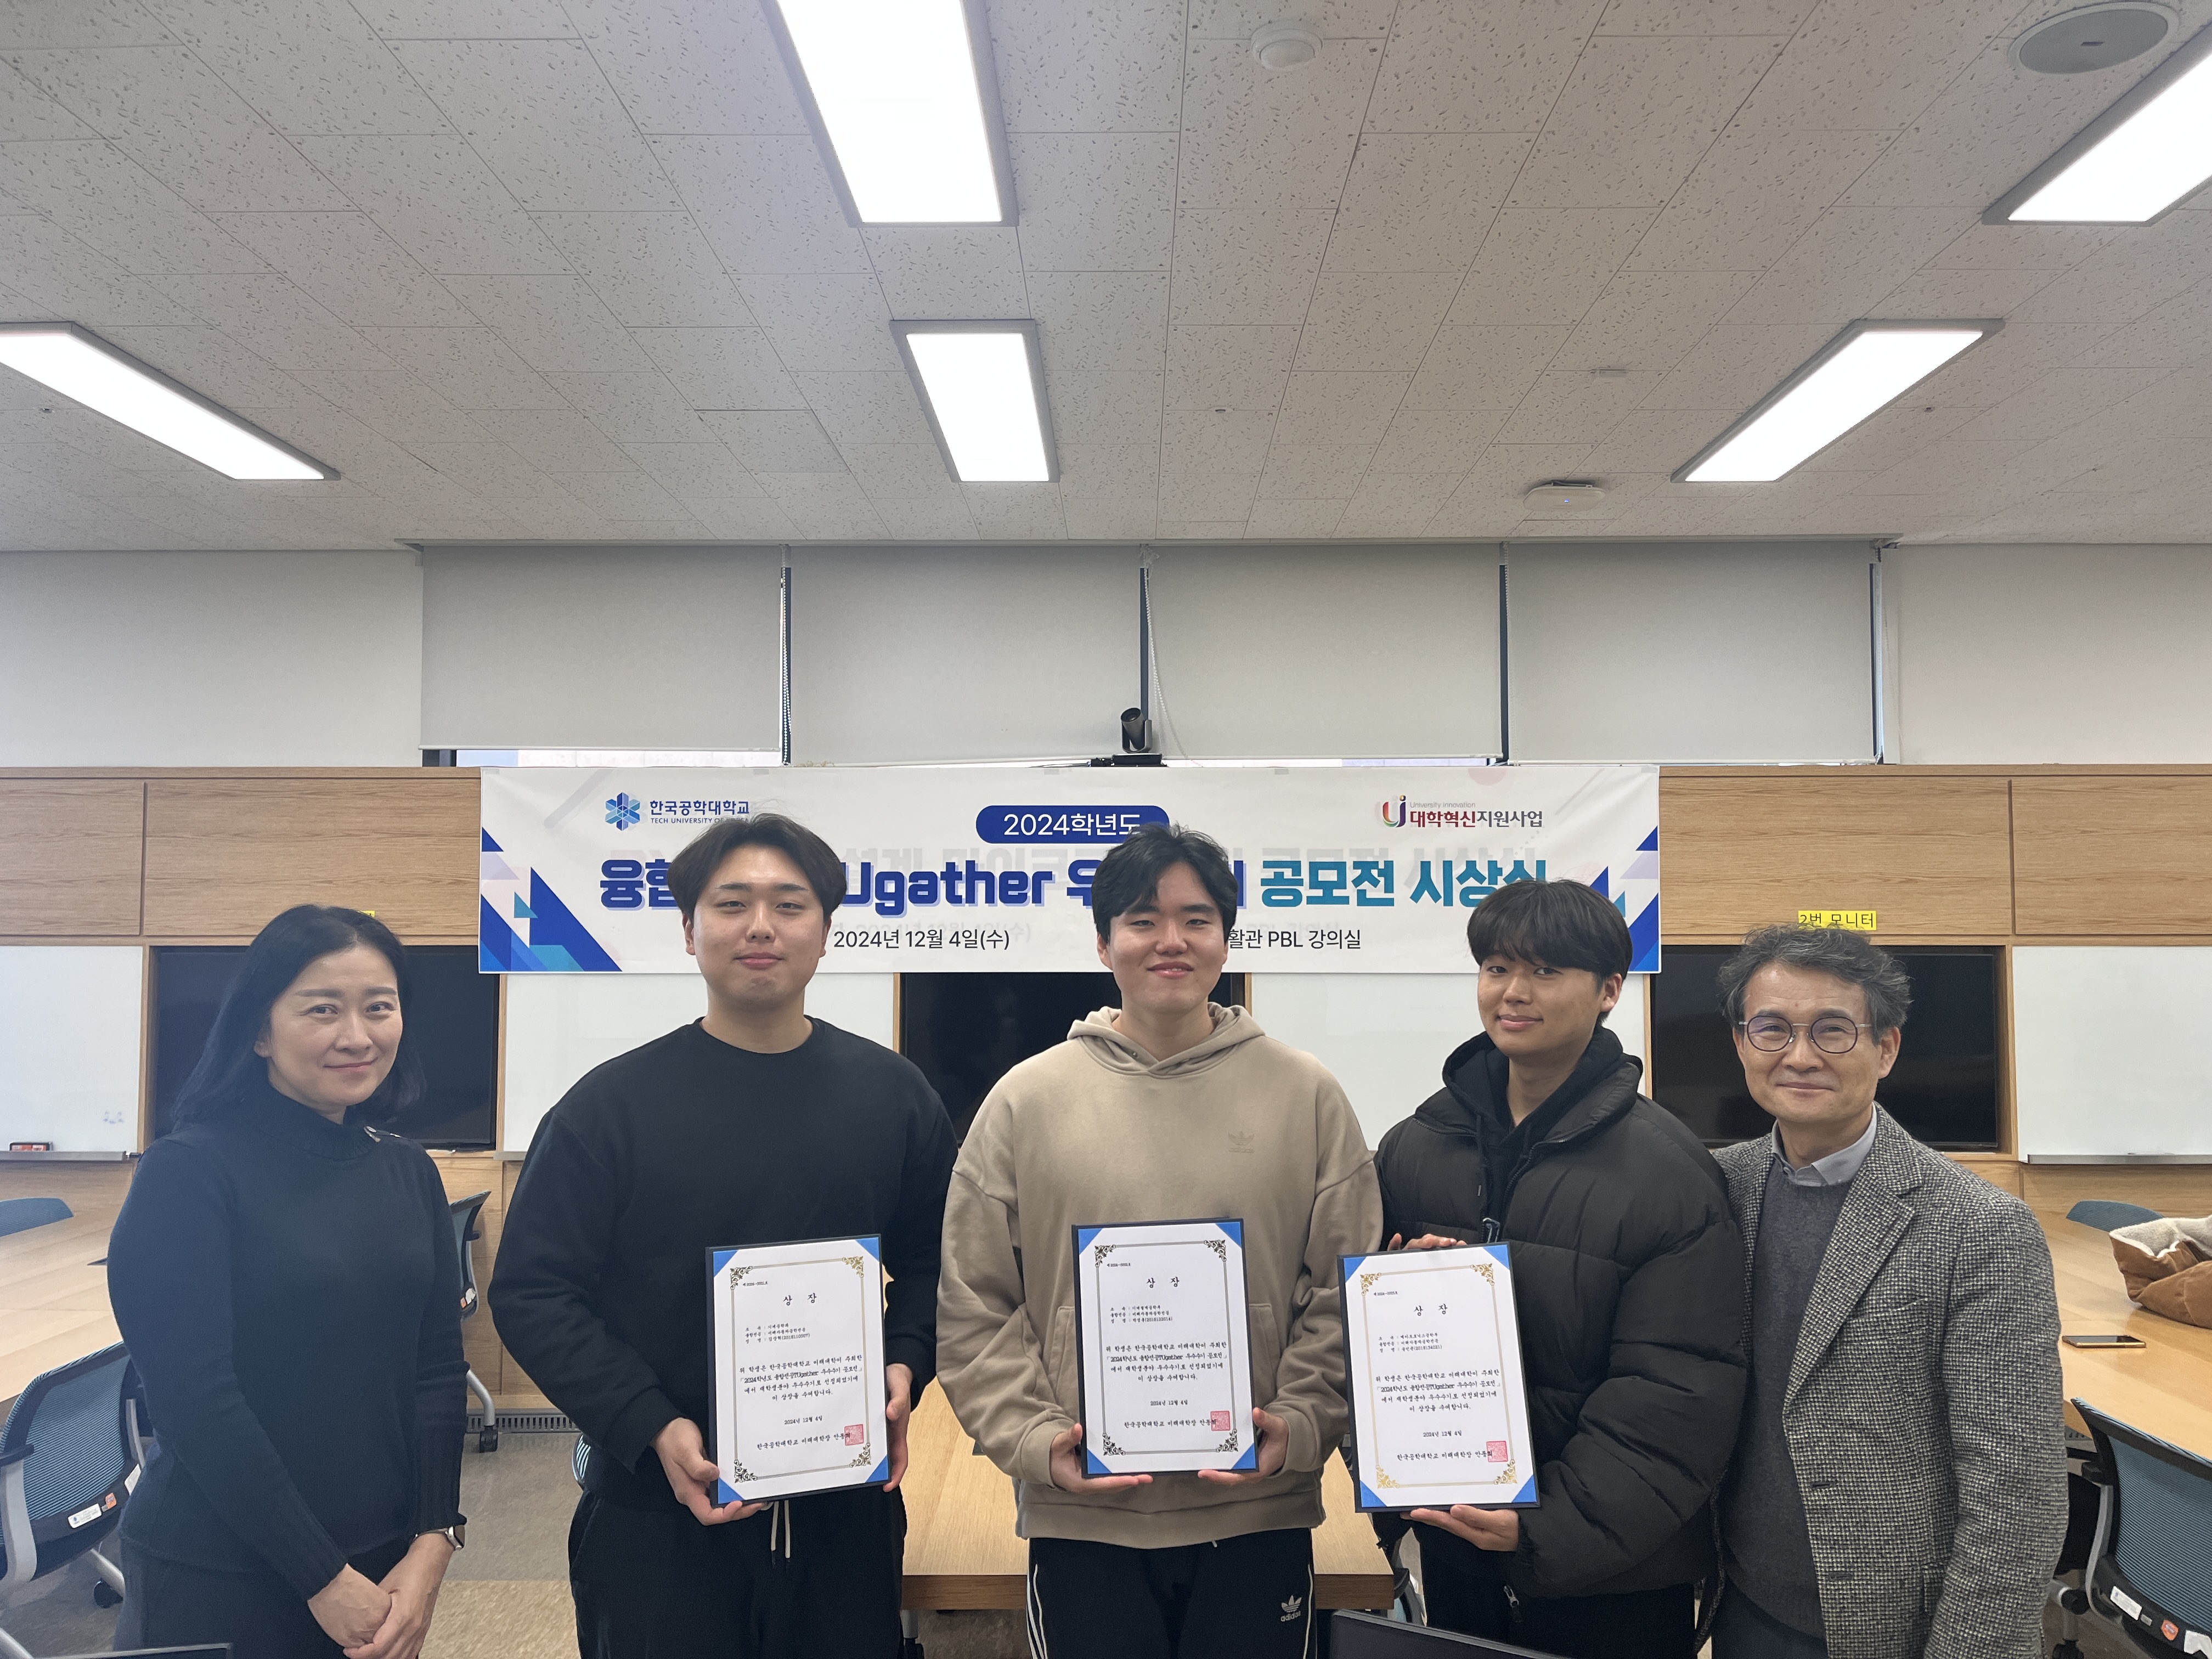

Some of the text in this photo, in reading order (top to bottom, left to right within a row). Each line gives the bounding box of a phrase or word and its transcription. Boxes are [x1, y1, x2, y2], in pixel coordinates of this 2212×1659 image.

[650, 800, 749, 816] 한국공학대학교
[1003, 813, 1141, 836] 2024학년도
[1410, 811, 1542, 827] 대학혁신지원사업
[1261, 860, 1395, 907] 공모전
[1831, 913, 1873, 928] 모니터
[833, 930, 899, 949] 2024년
[906, 930, 943, 949] 12월
[949, 929, 1009, 950] 4일(수)
[1268, 931, 1303, 947] PBL
[1308, 929, 1361, 950] 강의실
[1146, 1276, 1180, 1288] 상 장
[782, 1292, 817, 1306] 상 장
[1413, 1303, 1448, 1316] 상 장
[1177, 1341, 1206, 1350] 미래대학이
[1185, 1351, 1205, 1361] 우수수기
[748, 1364, 766, 1374] 학생은
[769, 1360, 811, 1371] 한국공학대학교
[813, 1356, 841, 1366] 미래대학이
[820, 1366, 840, 1375] 우수수기
[1156, 1363, 1186, 1371] 우수수기로
[1189, 1361, 1223, 1370] 선정되었기에
[1146, 1374, 1164, 1382] 상장을
[1166, 1373, 1198, 1381] 수여합니다.
[1404, 1372, 1446, 1381] 한국공학대학교
[1448, 1370, 1477, 1378] 미래대학이
[791, 1379, 821, 1389] 우수수기로
[824, 1375, 857, 1385] 선정되었기에
[1456, 1380, 1477, 1389] 우수수기
[781, 1392, 799, 1400] 상장을
[801, 1388, 832, 1397] 수여합니다.
[1428, 1392, 1458, 1401] 우수수기로
[1461, 1390, 1497, 1399] 선정되었기에
[1438, 1402, 1471, 1410] 수여합니다.
[1124, 1420, 1165, 1429] 한국공학대학교
[1167, 1419, 1197, 1427] 미래대학장
[757, 1439, 798, 1450] 한국공학대학교
[801, 1434, 830, 1444] 미래대학장
[1397, 1452, 1438, 1461] 한국공학대학교
[1441, 1451, 1472, 1459] 미래대학장
[1280, 1611, 1301, 1622] adidas
